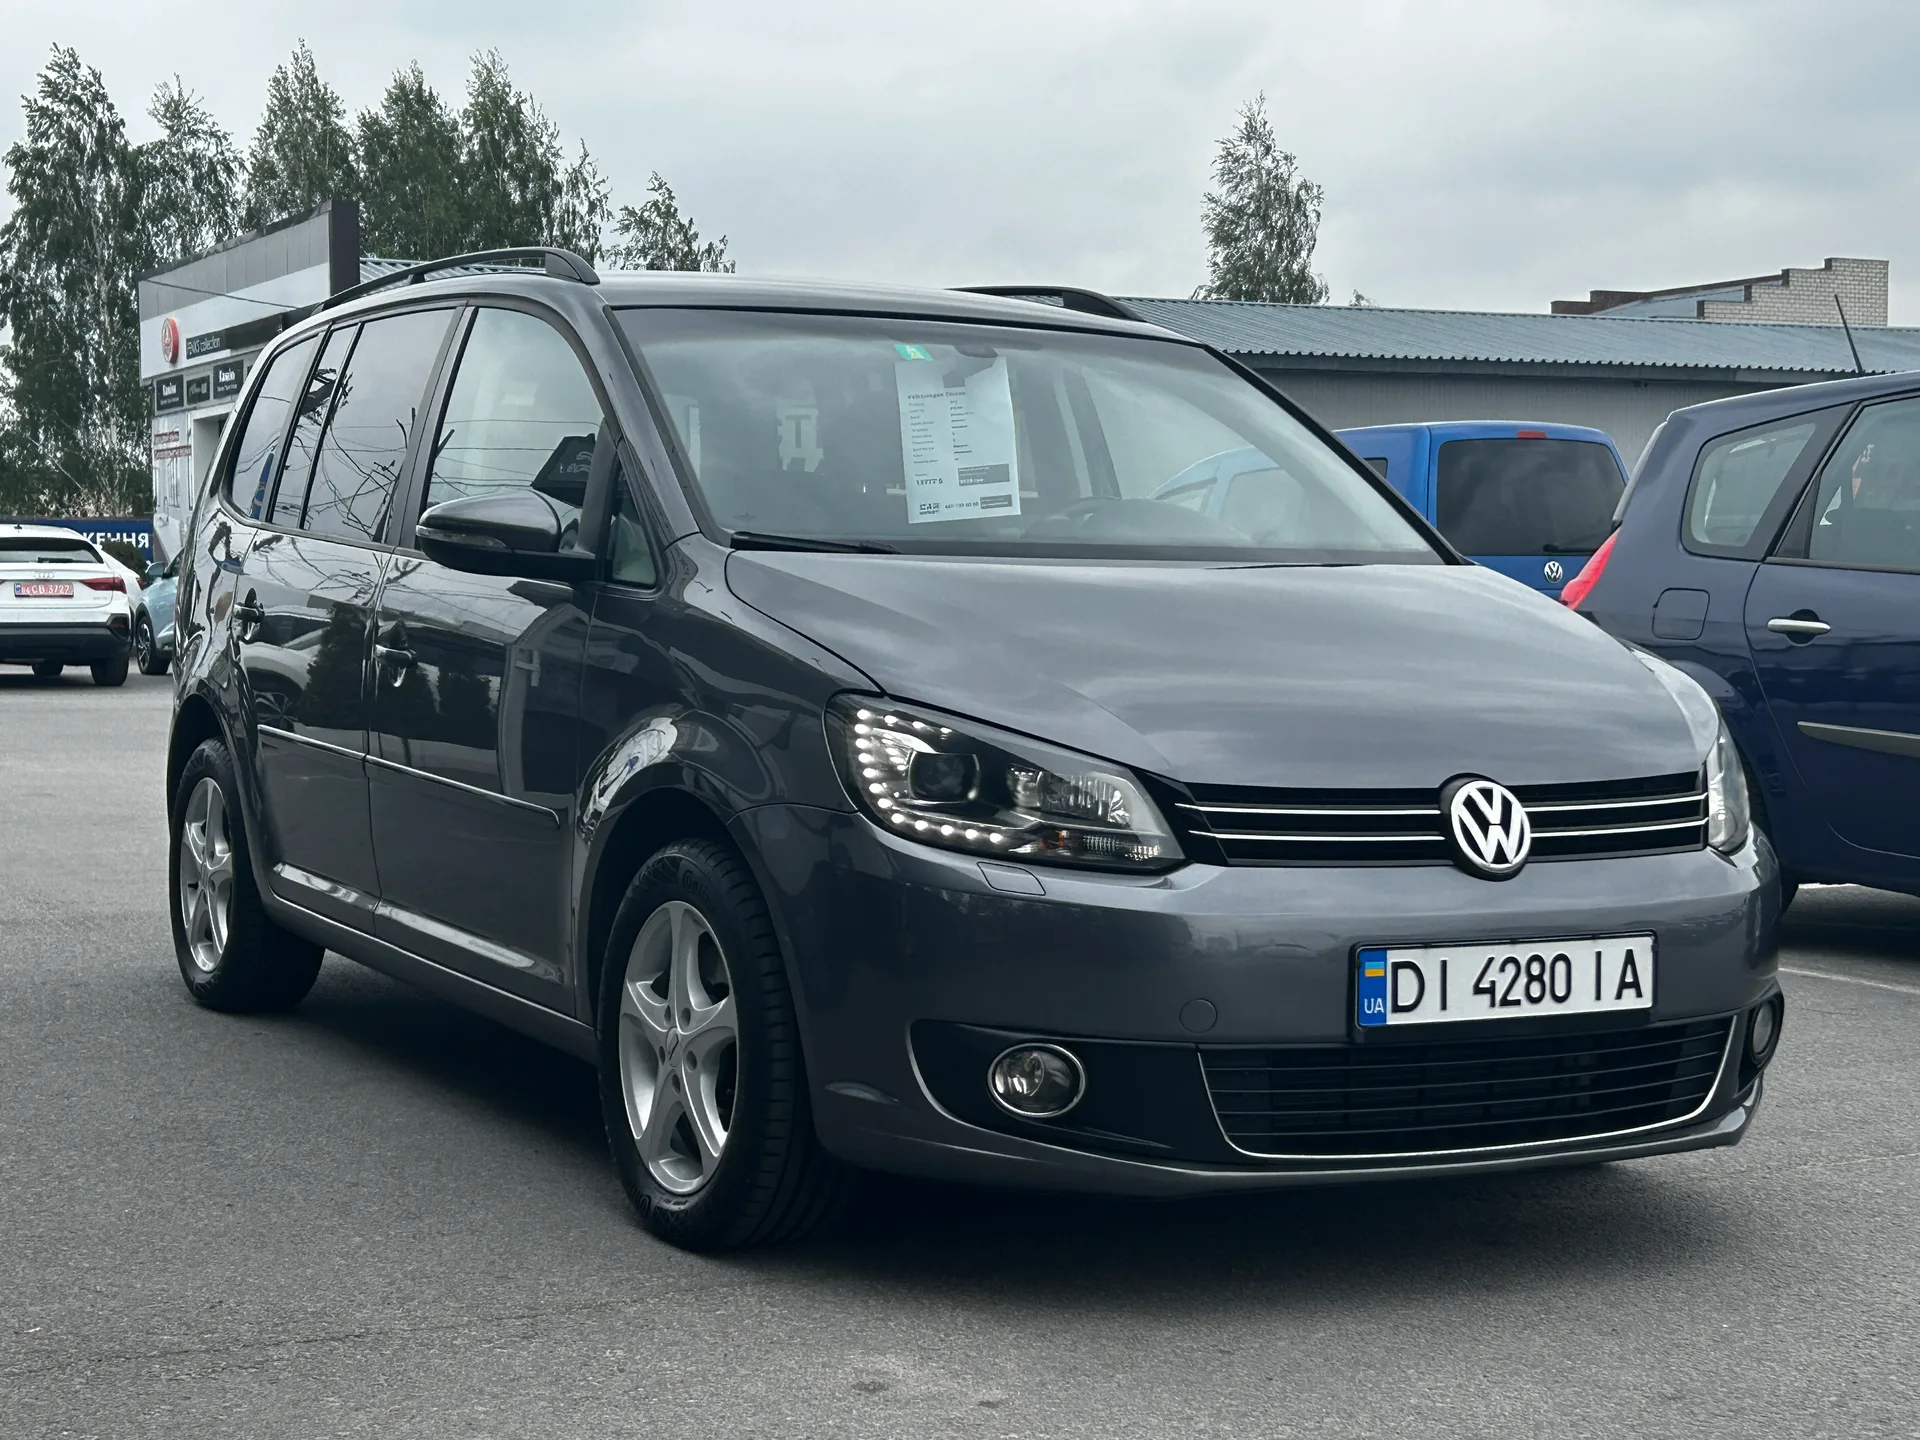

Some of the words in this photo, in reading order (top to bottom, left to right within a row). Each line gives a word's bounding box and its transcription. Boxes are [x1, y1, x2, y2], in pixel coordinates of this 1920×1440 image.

[1391, 959, 1448, 1014] DI
[1473, 953, 1572, 1009] 4280
[1595, 949, 1644, 1002] IA
[1364, 998, 1385, 1014] UA
